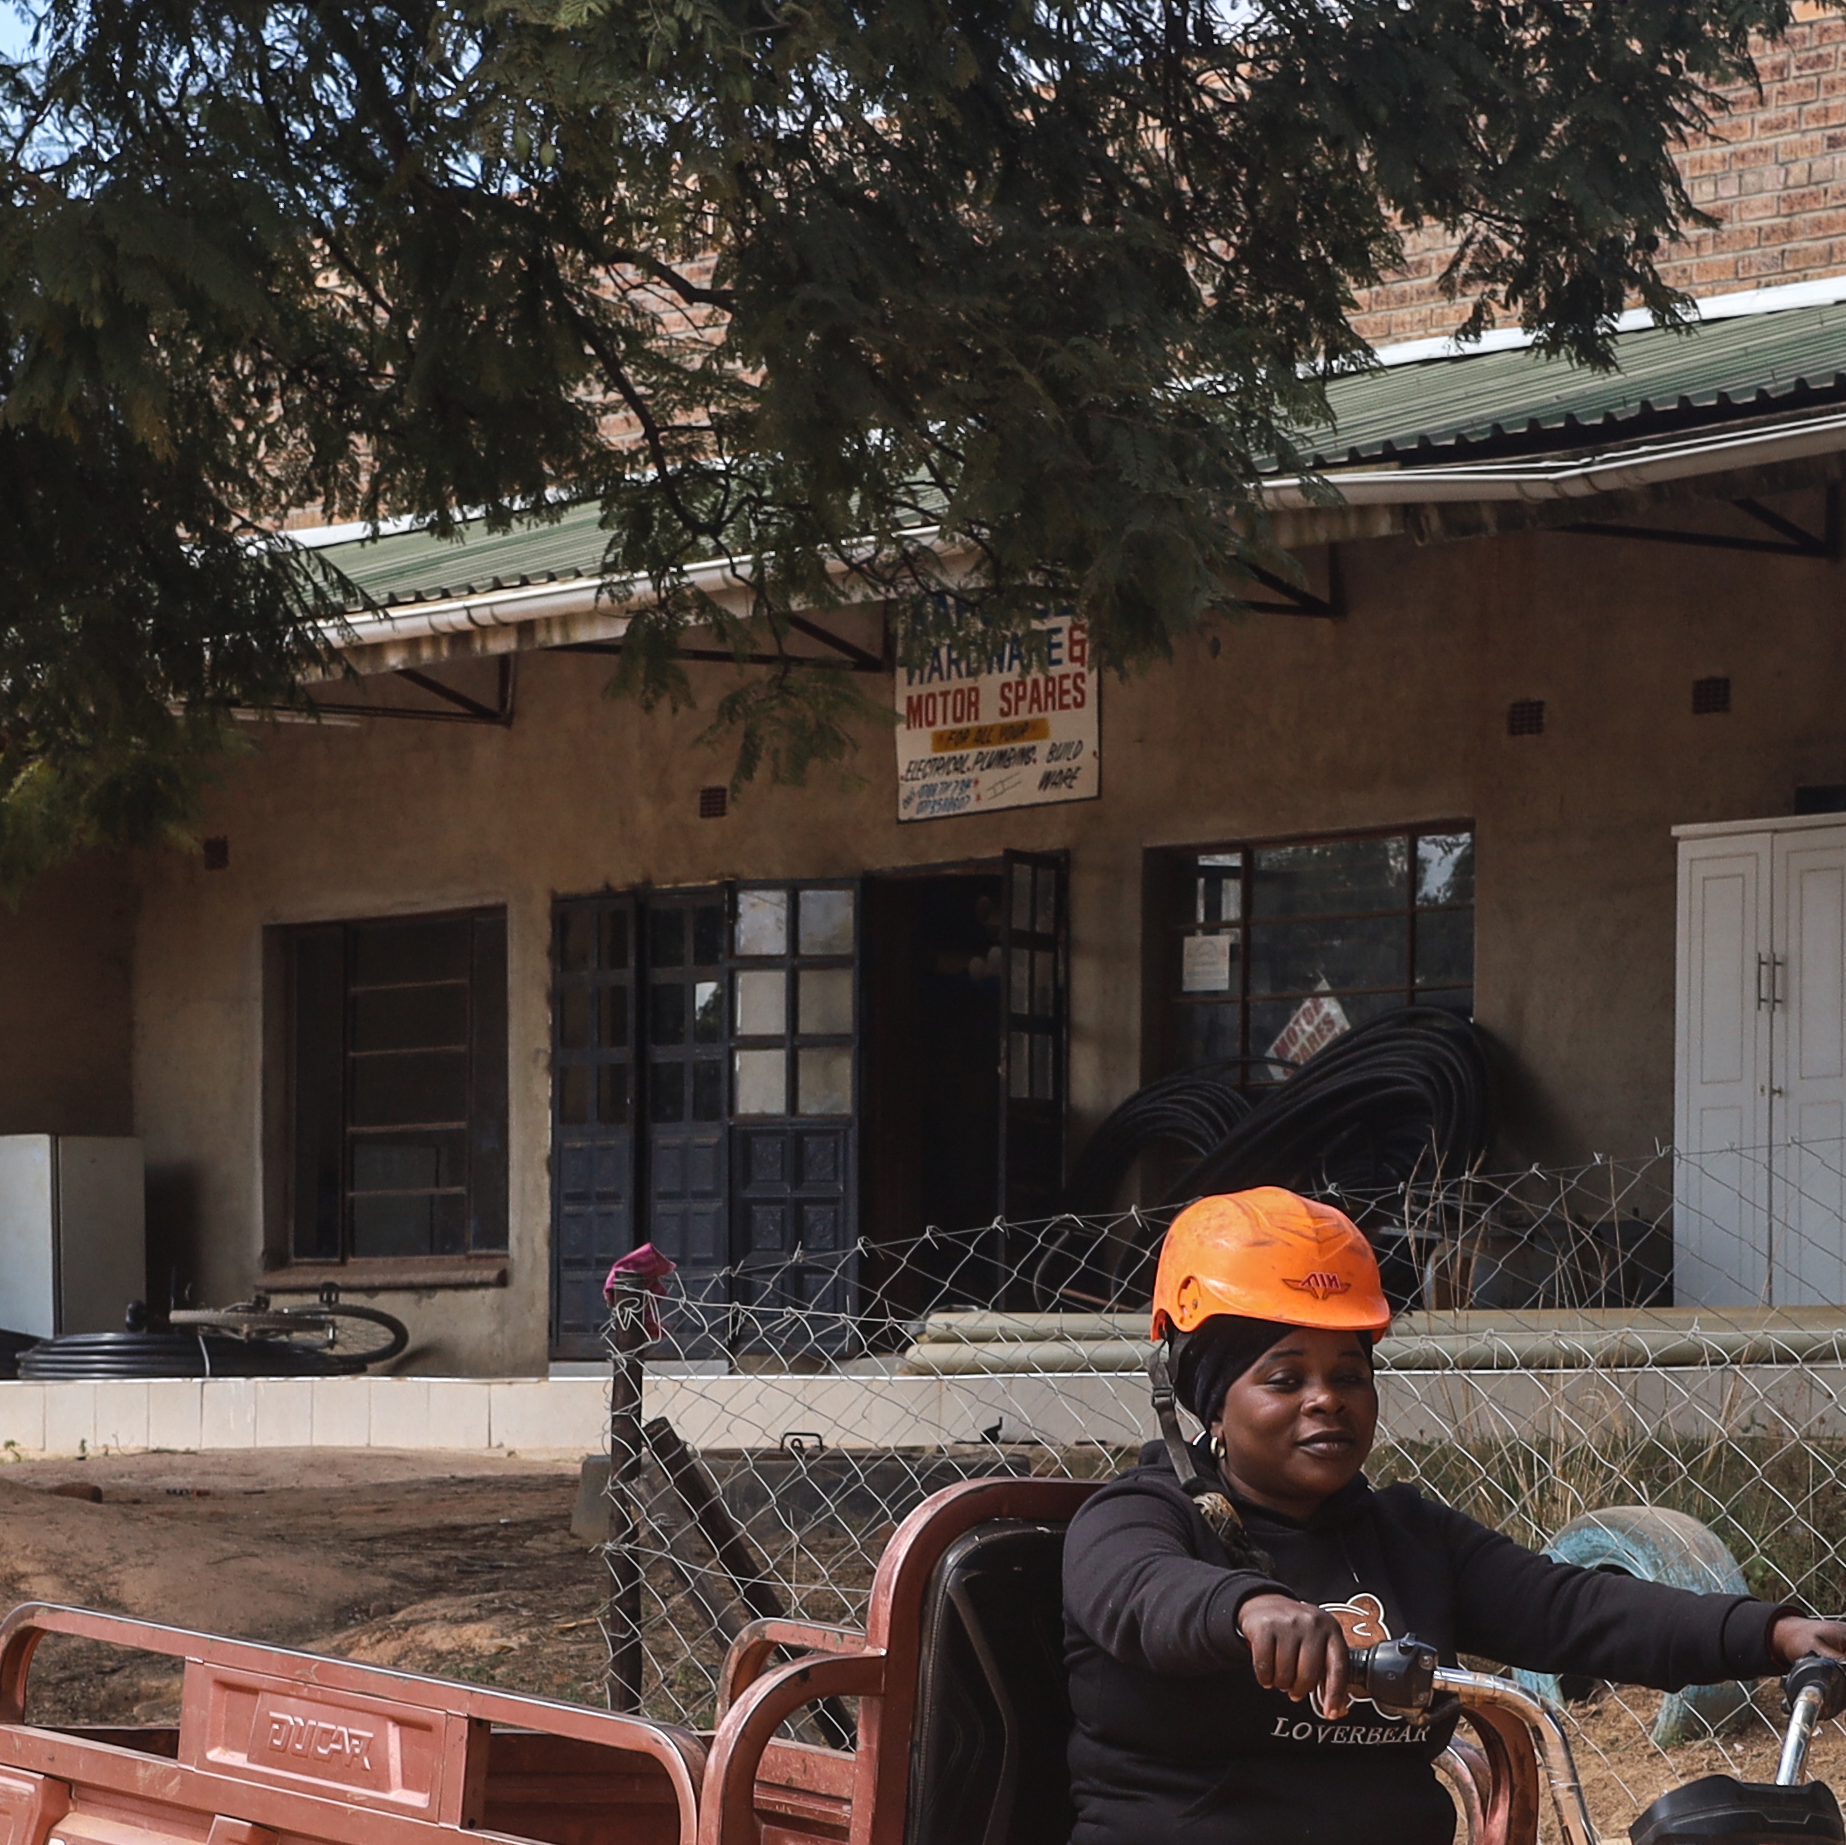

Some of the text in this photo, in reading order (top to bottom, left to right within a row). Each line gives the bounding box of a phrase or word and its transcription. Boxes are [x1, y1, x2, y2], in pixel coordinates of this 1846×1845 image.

[906, 672, 1086, 731] MOTOR SPARES
[1046, 740, 1084, 764] BUILD
[1038, 766, 1081, 792] WARE
[268, 1711, 374, 1772] DUCAR
[1270, 1717, 1432, 1745] LOVERBEAR
